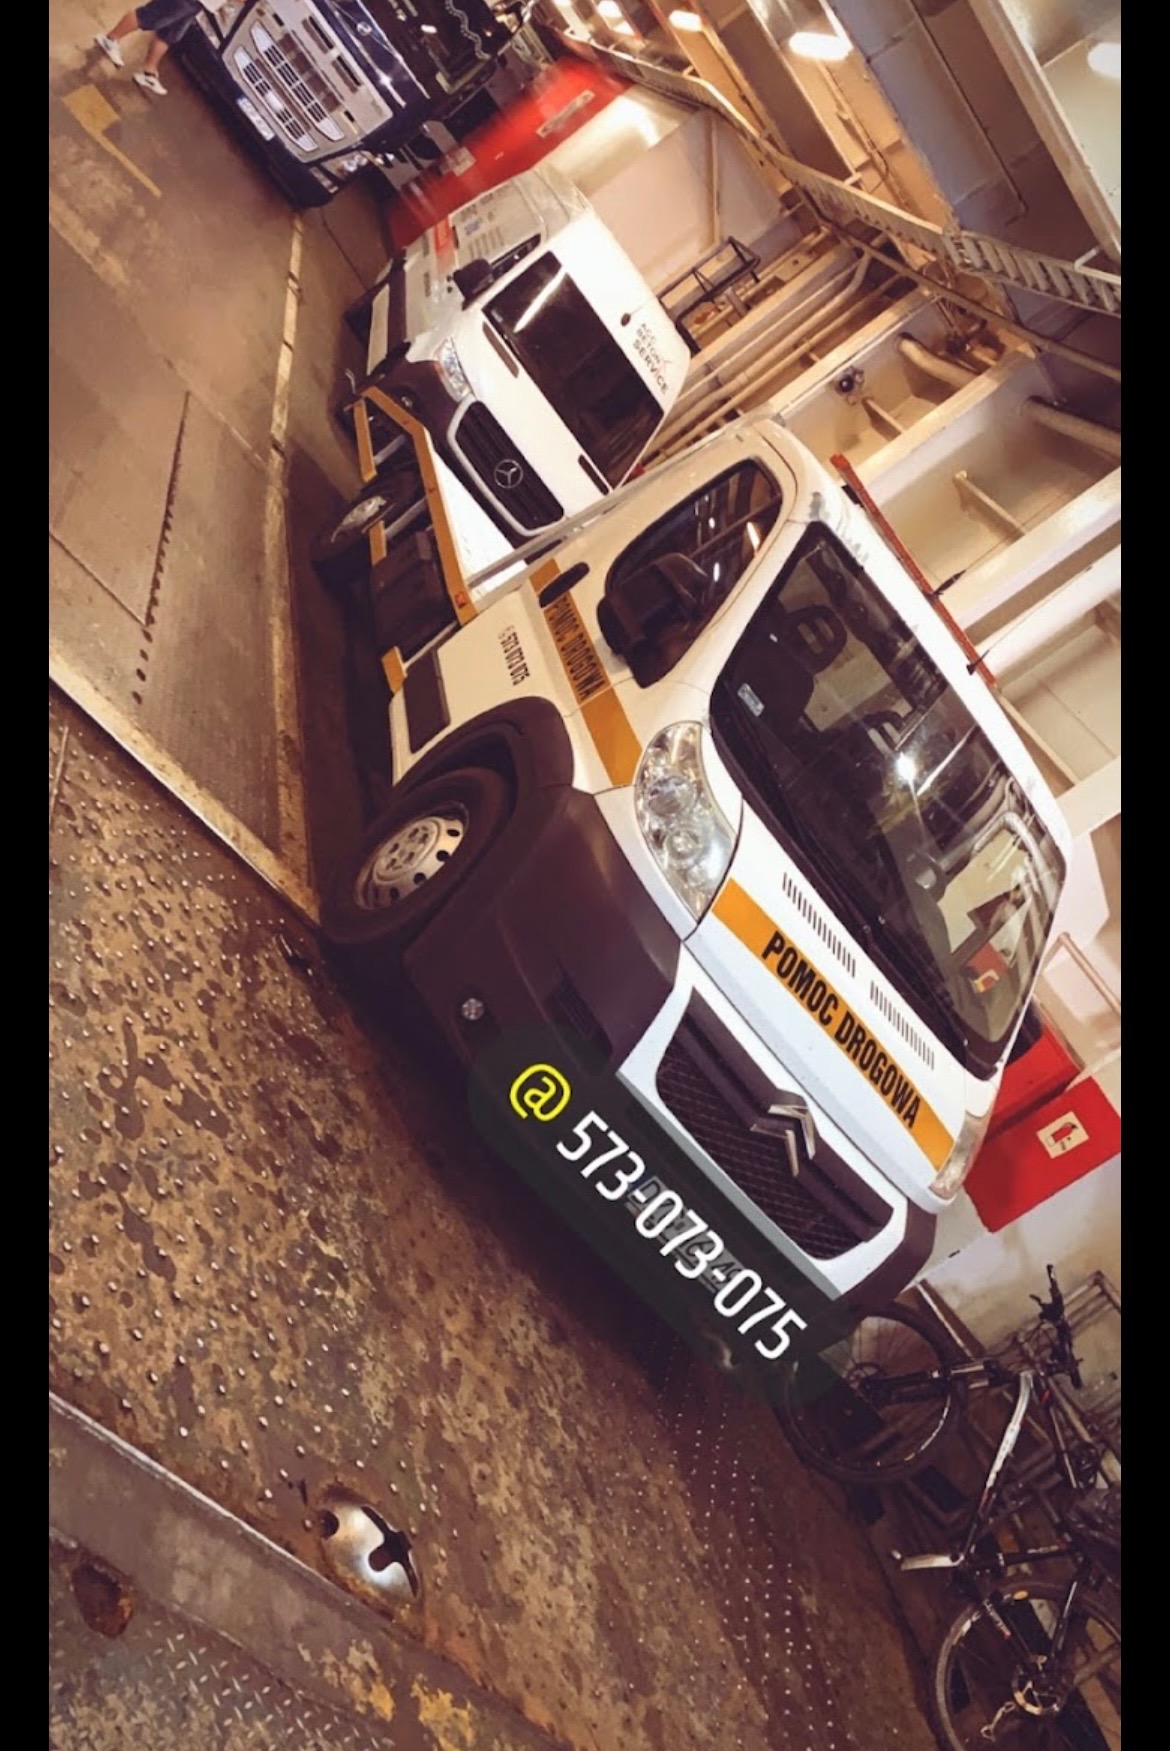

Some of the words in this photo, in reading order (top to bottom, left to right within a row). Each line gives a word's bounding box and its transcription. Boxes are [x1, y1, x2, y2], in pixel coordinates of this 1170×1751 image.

[560, 632, 606, 701] DROGOWA
[761, 930, 839, 1027] POMOC
[834, 1010, 922, 1130] DROGOWA
